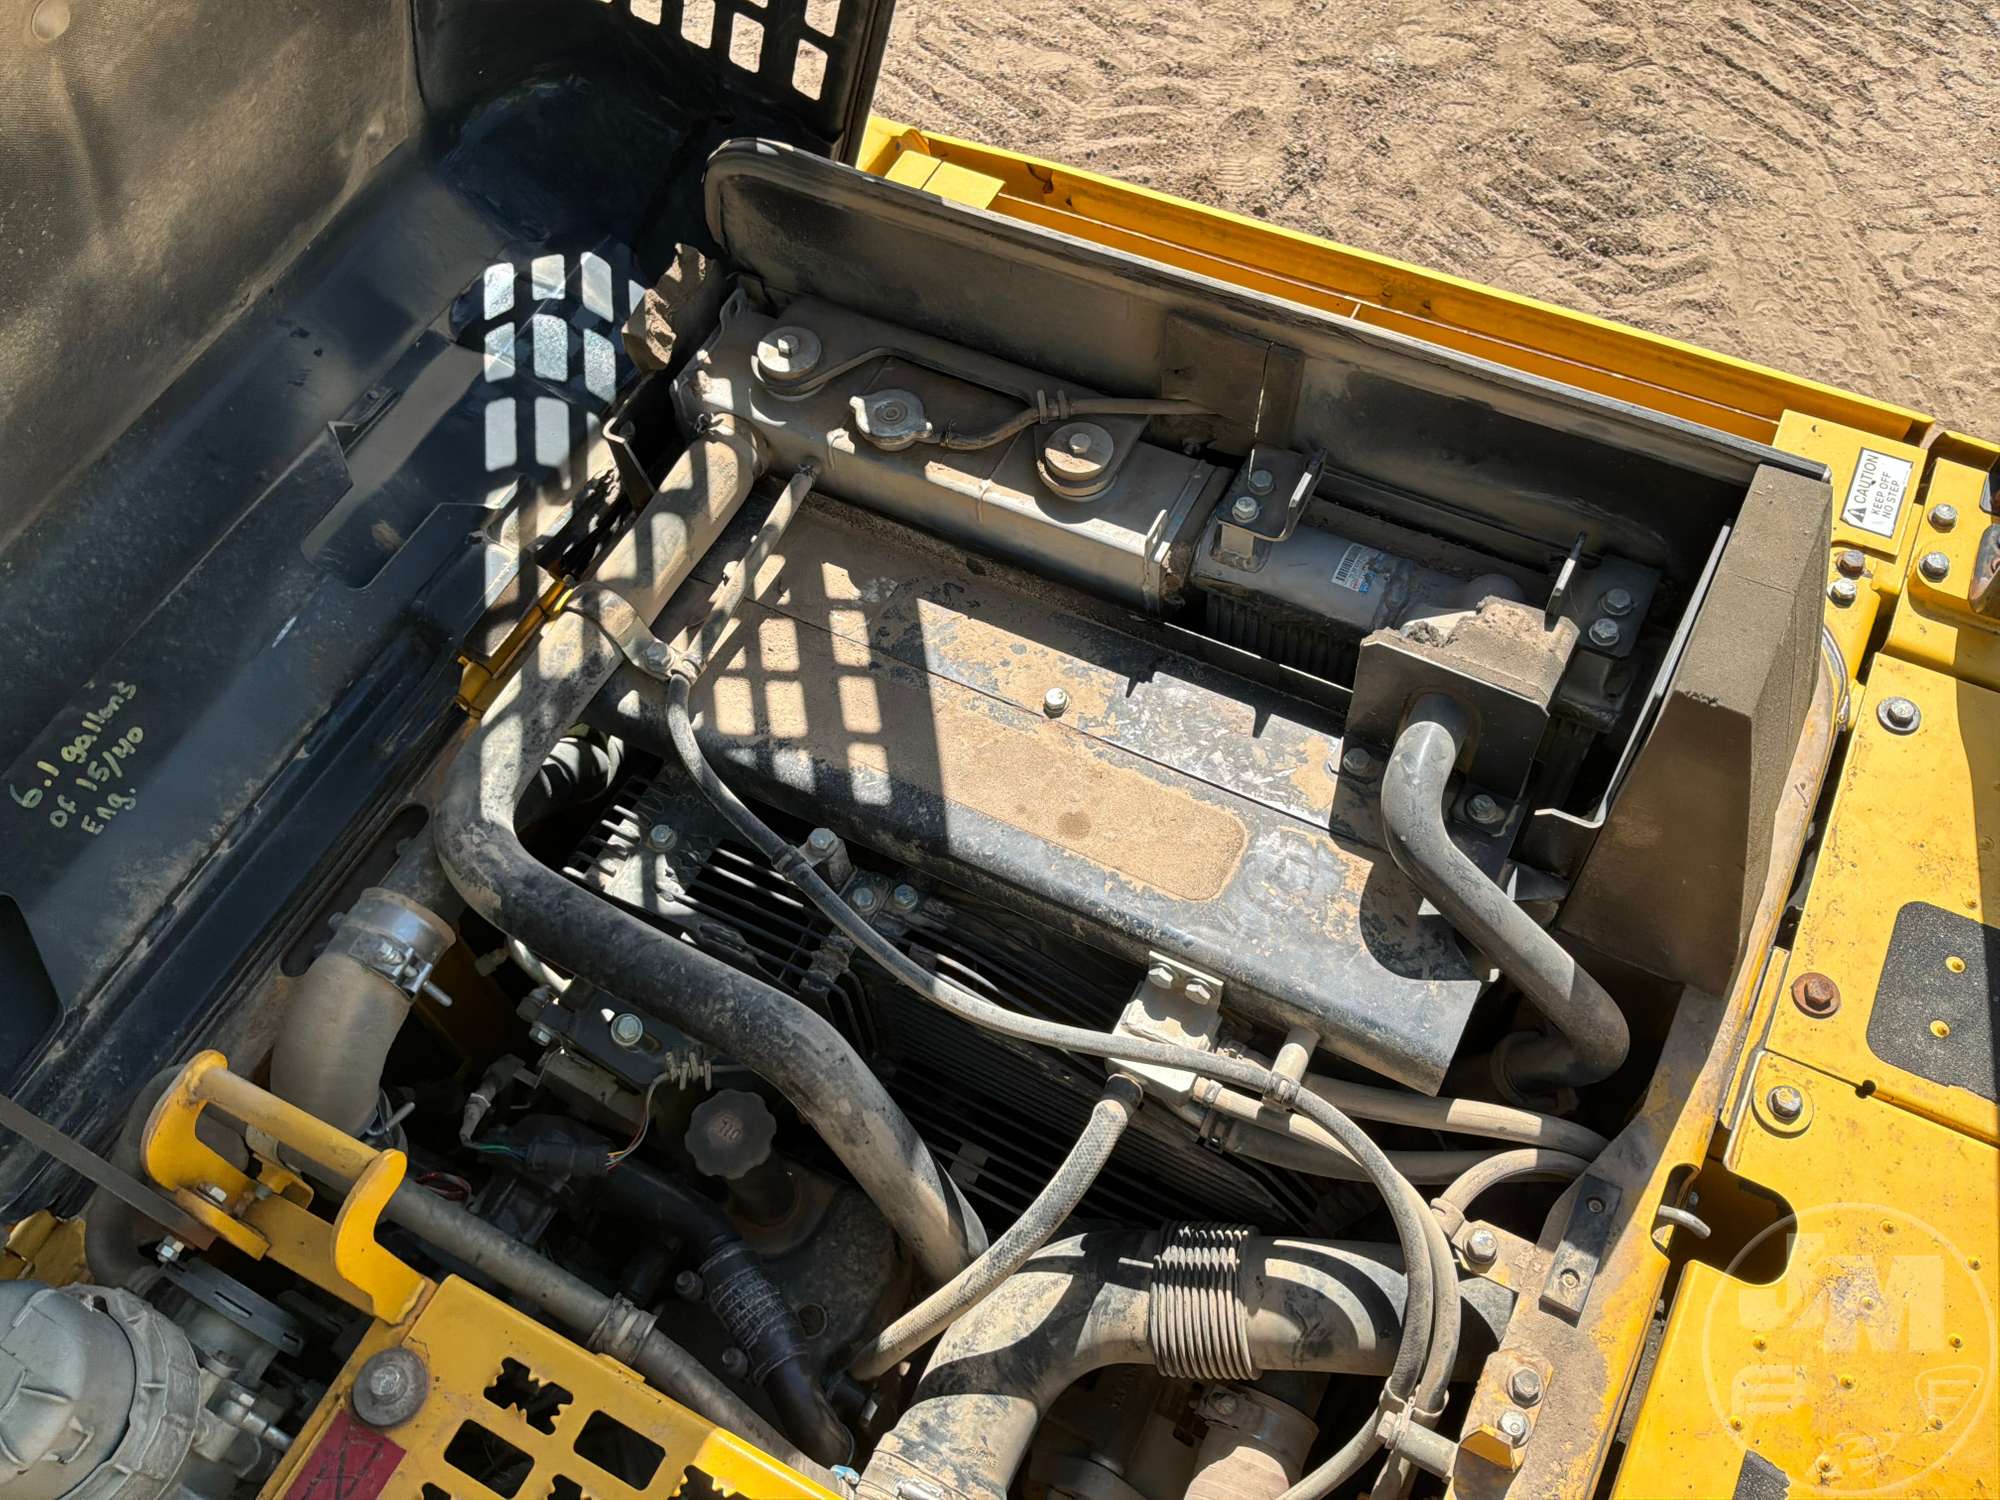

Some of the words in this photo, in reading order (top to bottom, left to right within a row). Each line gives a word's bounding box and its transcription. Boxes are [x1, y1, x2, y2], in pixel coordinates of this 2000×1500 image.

[1854, 454, 1879, 504] CAUTION
[1871, 490, 1885, 515] KEEP
[1879, 471, 1891, 490] OFF
[1886, 480, 1900, 503] STEP
[1882, 505, 1894, 519] NO
[9, 761, 60, 808] 6.1
[61, 681, 137, 763] gallons
[76, 726, 144, 791] 15/40
